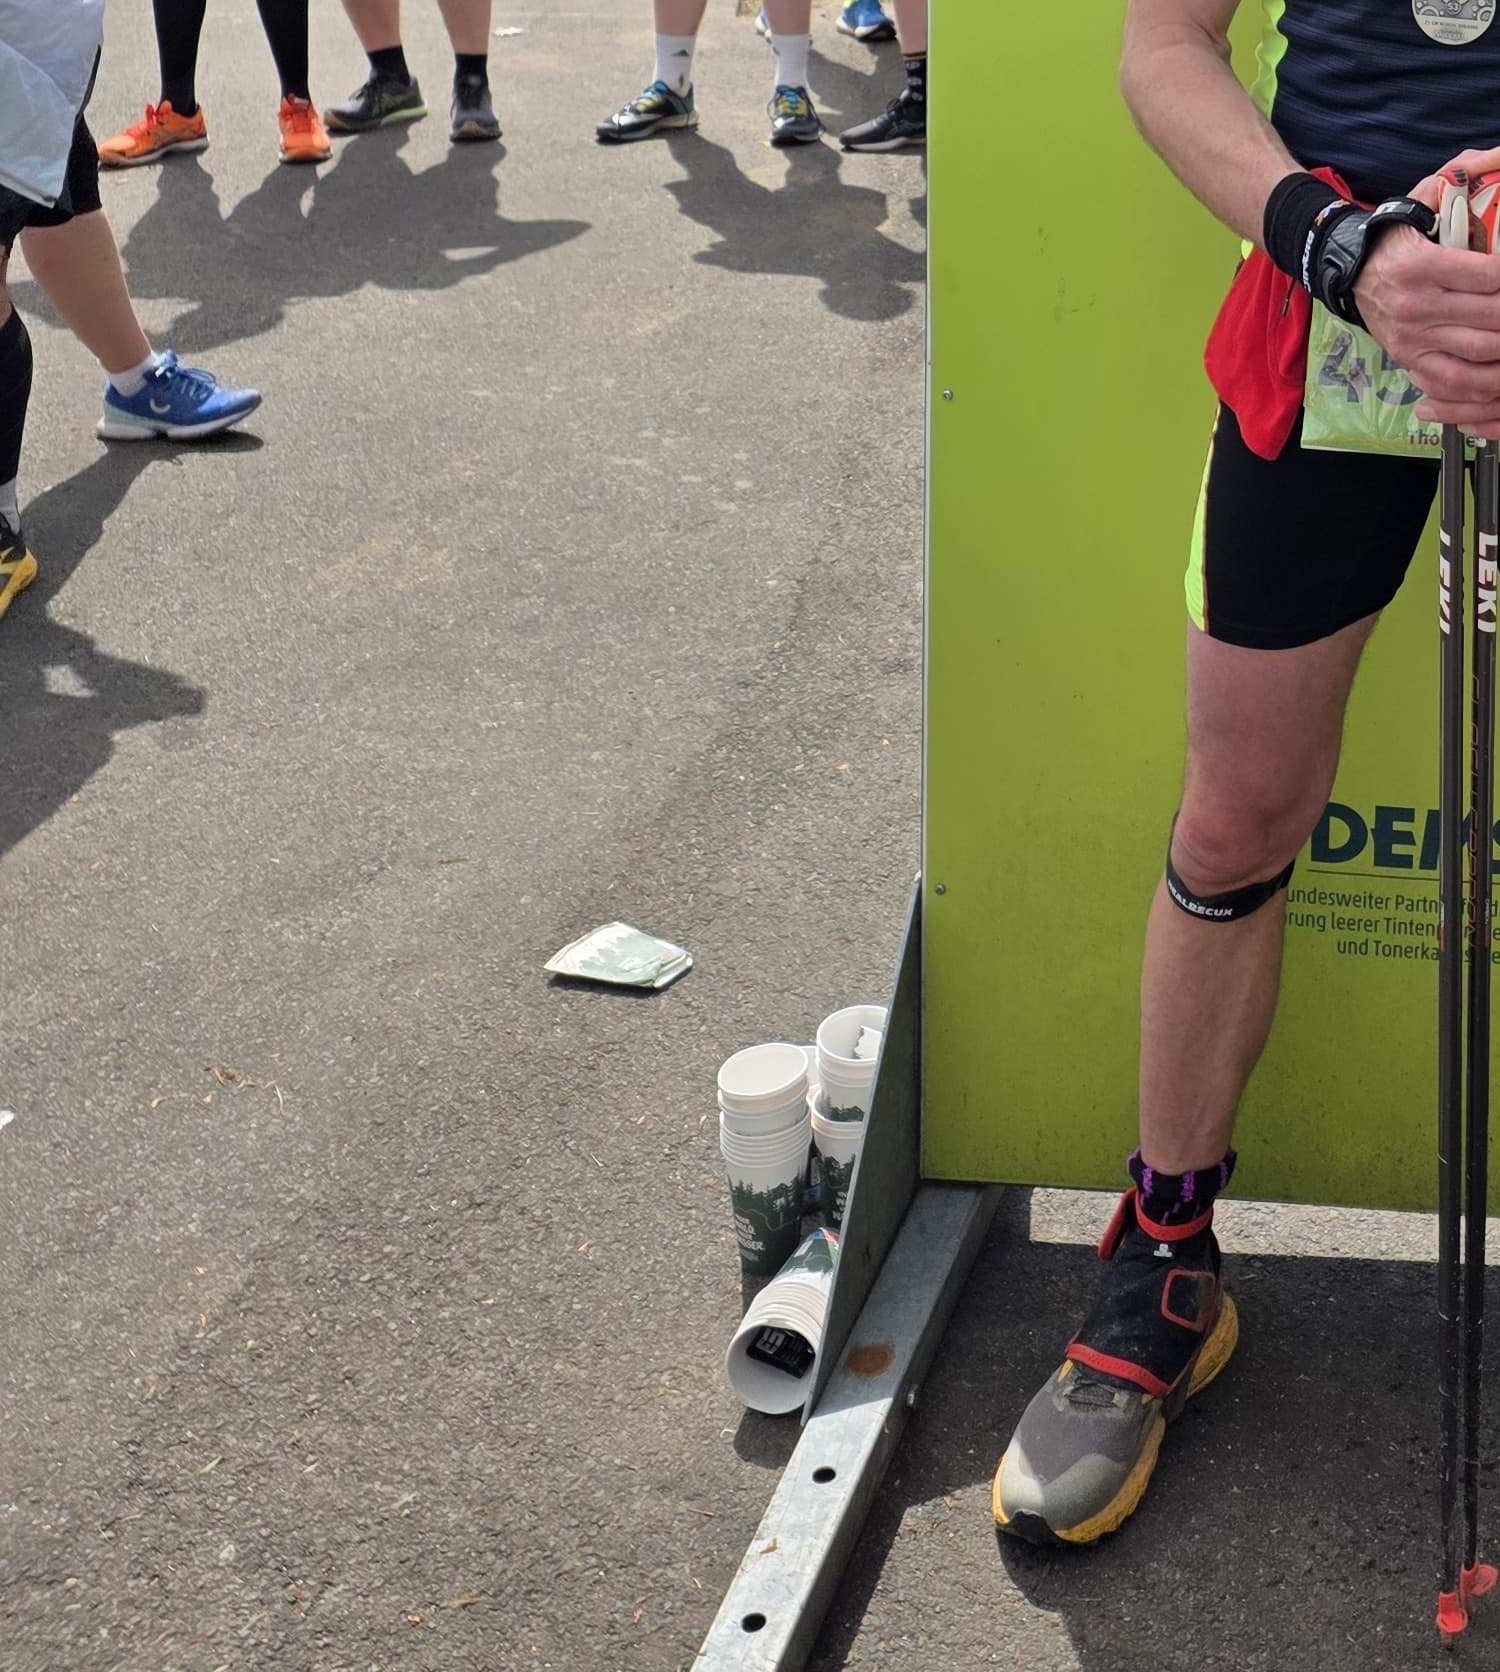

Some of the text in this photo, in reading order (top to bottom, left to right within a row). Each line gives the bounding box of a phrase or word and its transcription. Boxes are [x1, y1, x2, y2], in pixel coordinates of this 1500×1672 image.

[1477, 531, 1499, 633] LEKI
[1286, 886, 1390, 912] undesweiter
[1394, 892, 1439, 914] Partn
[1331, 913, 1378, 932] leerer
[1336, 937, 1367, 956] und
